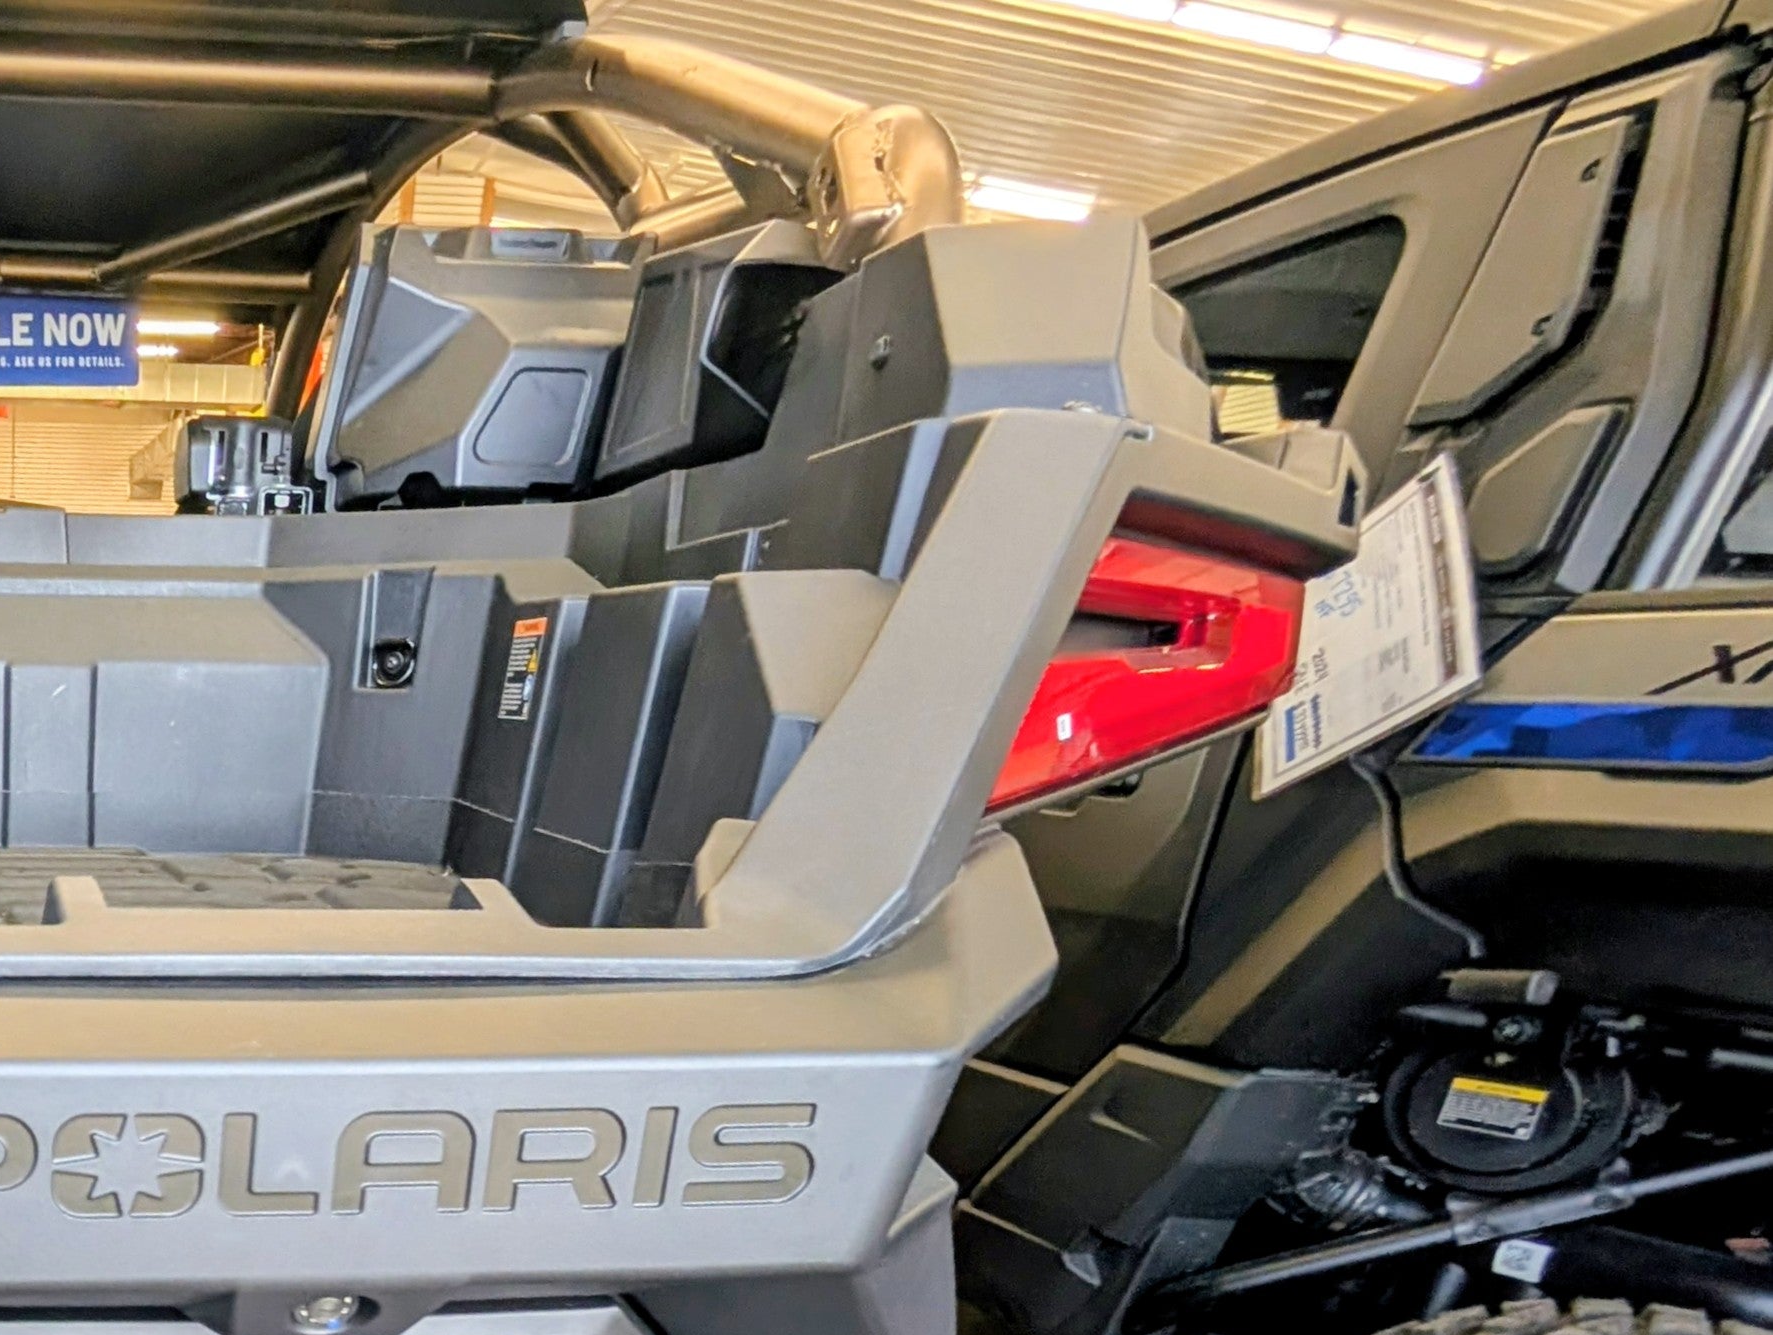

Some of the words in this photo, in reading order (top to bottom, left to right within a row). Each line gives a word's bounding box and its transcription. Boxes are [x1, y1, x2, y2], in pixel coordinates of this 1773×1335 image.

[43, 312, 126, 347] NOW
[14, 355, 35, 368] ASK
[38, 355, 52, 368] US
[55, 355, 75, 368] FOR
[78, 355, 126, 368] DETAILS.
